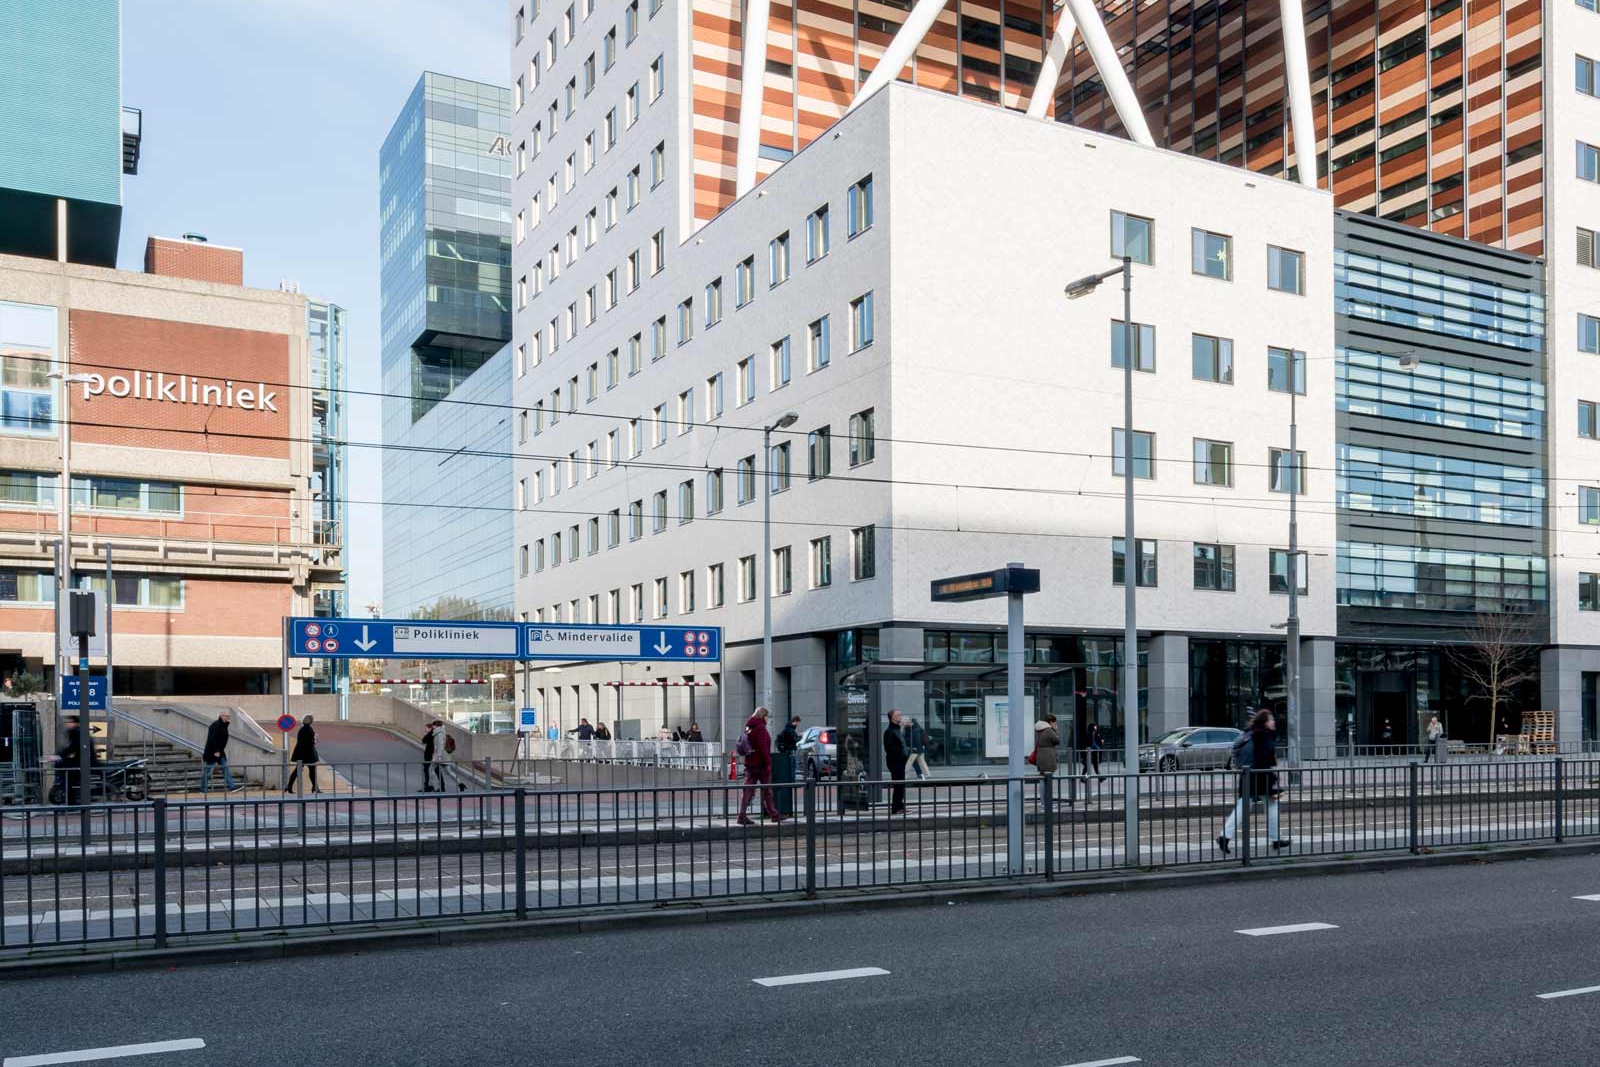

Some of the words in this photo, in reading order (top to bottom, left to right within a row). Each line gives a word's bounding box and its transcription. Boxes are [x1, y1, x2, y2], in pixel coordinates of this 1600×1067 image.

[83, 370, 278, 413] polikliniek
[414, 630, 480, 640] Polikliniek
[558, 632, 634, 642] Mindervalide
